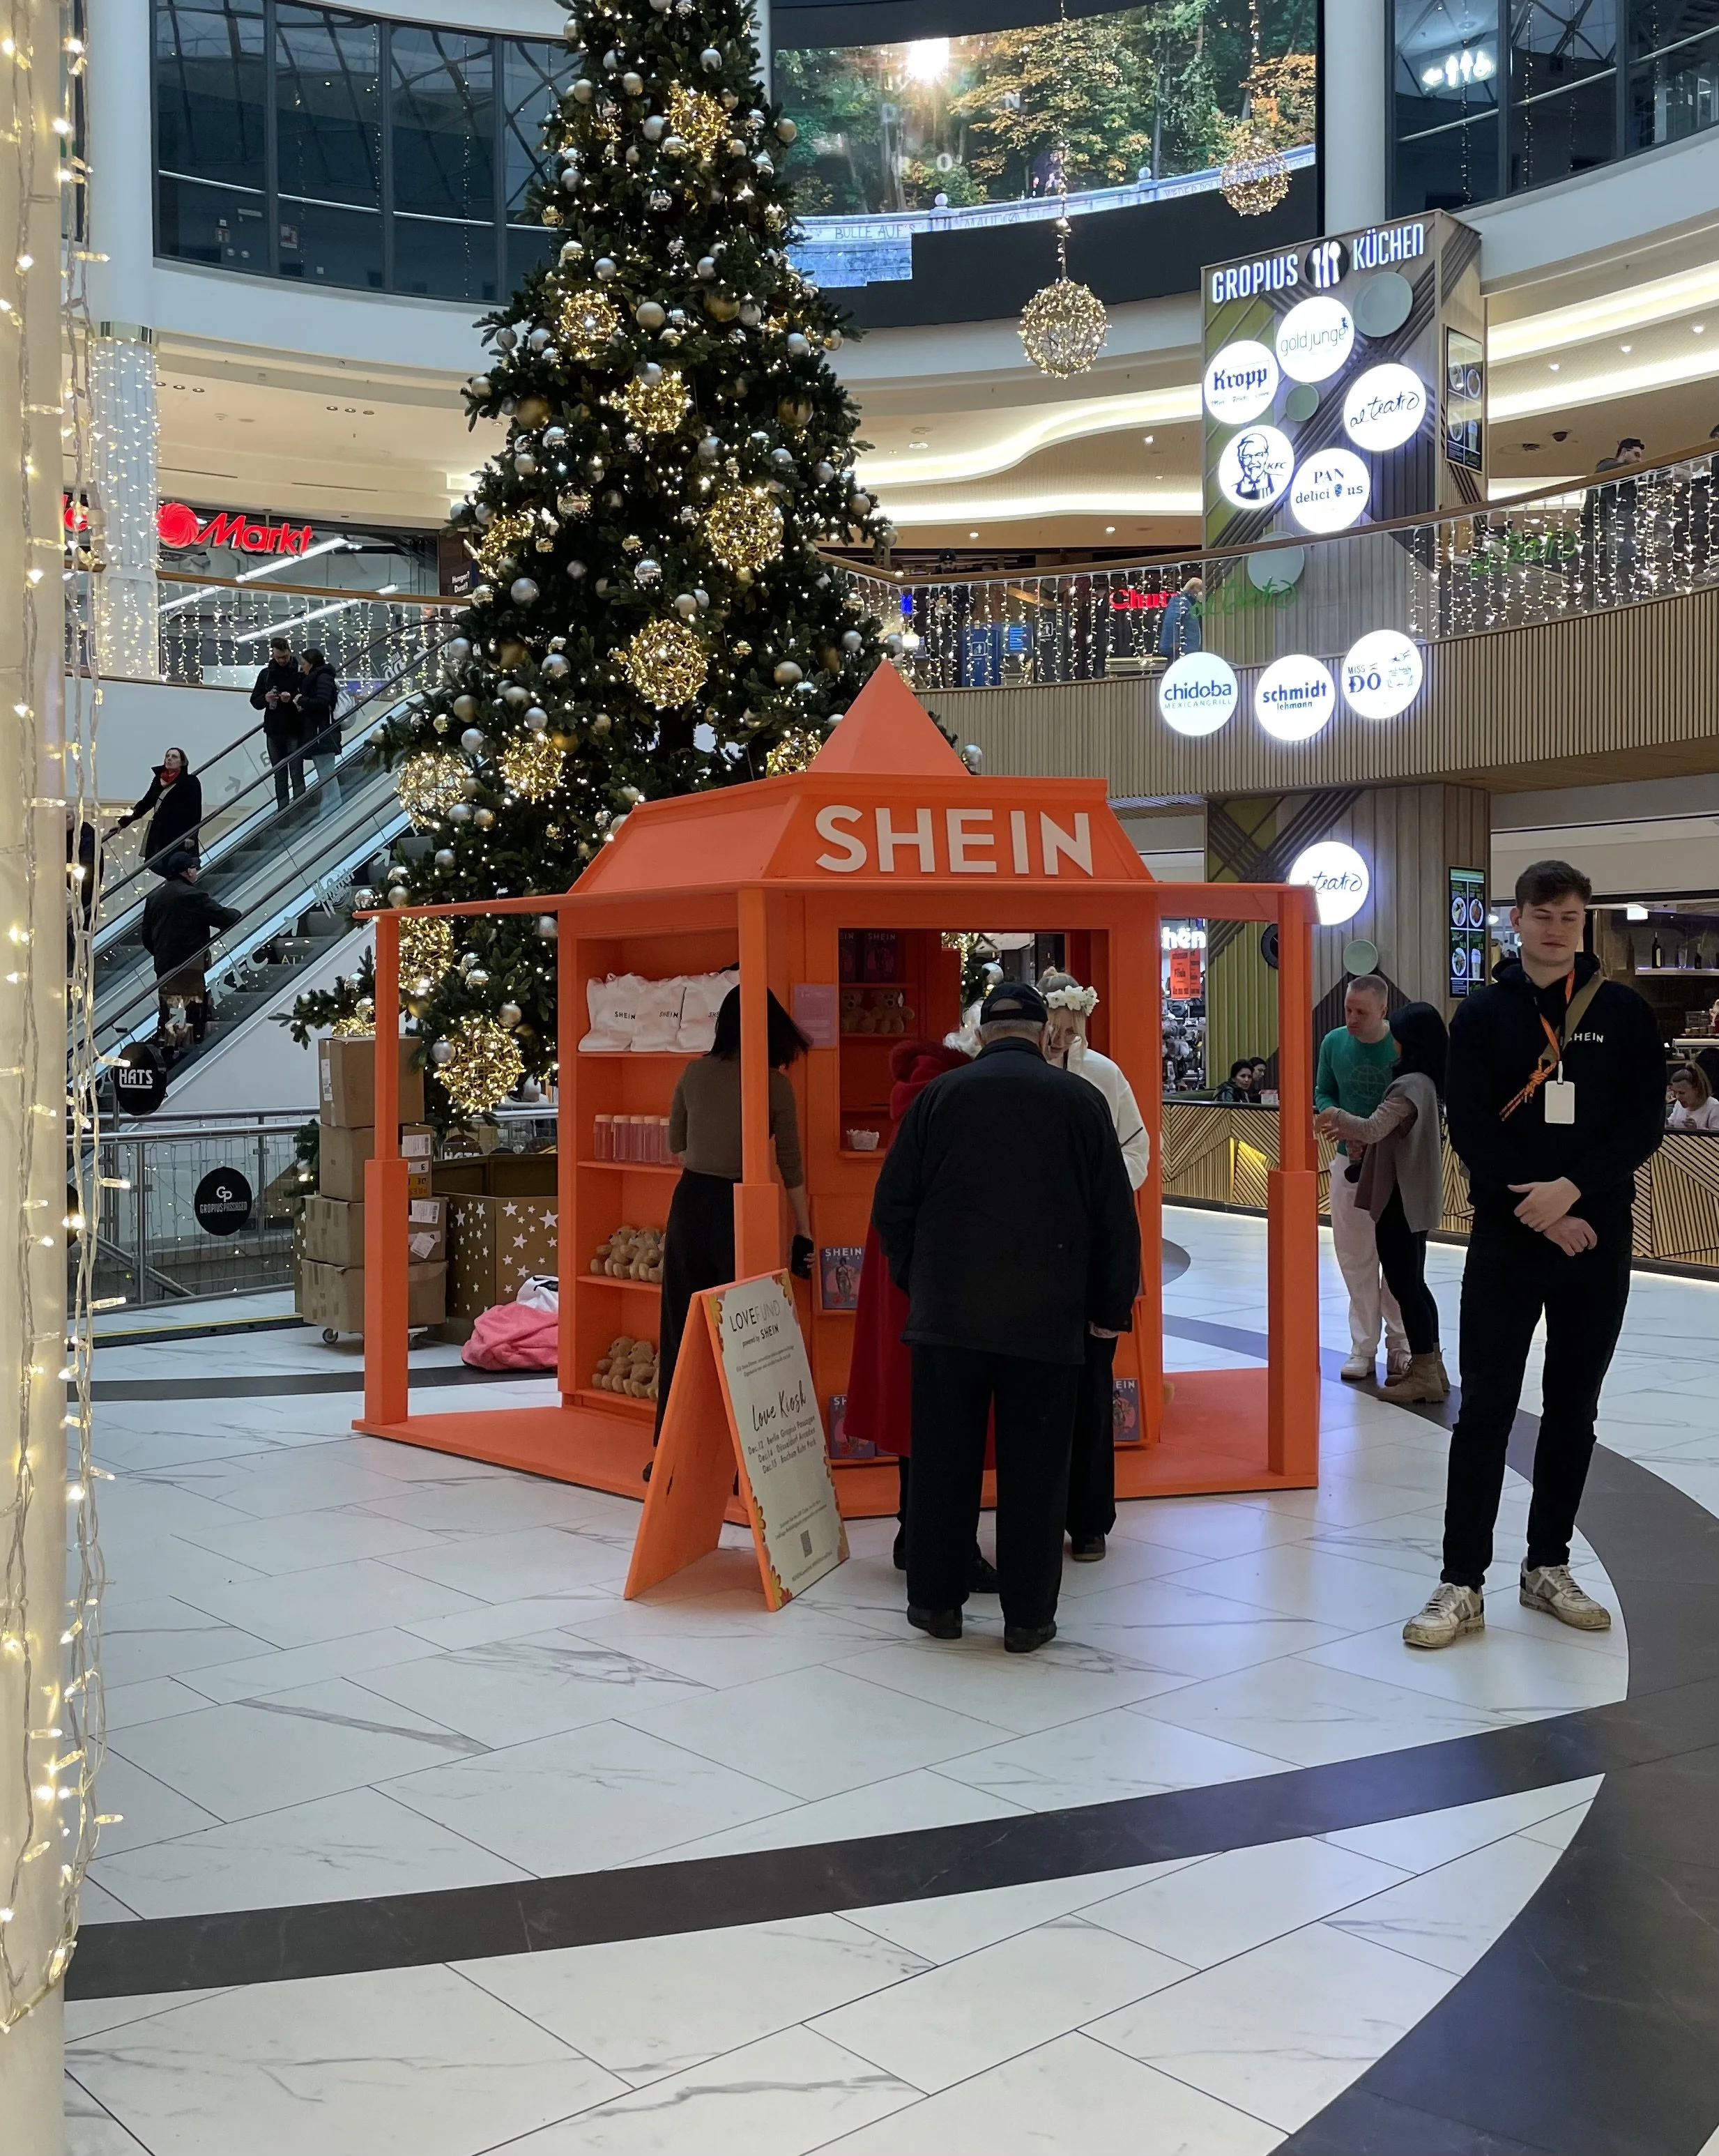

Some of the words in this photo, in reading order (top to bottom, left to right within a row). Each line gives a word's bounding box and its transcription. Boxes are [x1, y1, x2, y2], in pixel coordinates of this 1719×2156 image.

[1212, 254, 1299, 304] GROPIUS
[1353, 222, 1423, 271] KÜCHEN
[1214, 368, 1267, 390] Kropp
[1267, 461, 1288, 470] KFC
[1314, 468, 1344, 484] PAN
[196, 512, 313, 556] Markt
[1347, 664, 1366, 675] MISS
[1164, 680, 1232, 702] chidoba
[1262, 680, 1327, 703] schmidt
[1276, 700, 1313, 711] lehmann
[815, 804, 1094, 877] SHEIN
[867, 932, 896, 941] SHEIN
[614, 1011, 636, 1020] SHEIN
[659, 1011, 679, 1019] SHEIN
[1568, 1032, 1604, 1044] HEIN
[119, 1069, 153, 1087] HATS
[825, 1247, 862, 1257] SHEIN
[760, 1324, 779, 1340] SHEIN
[752, 1404, 777, 1432] Love
